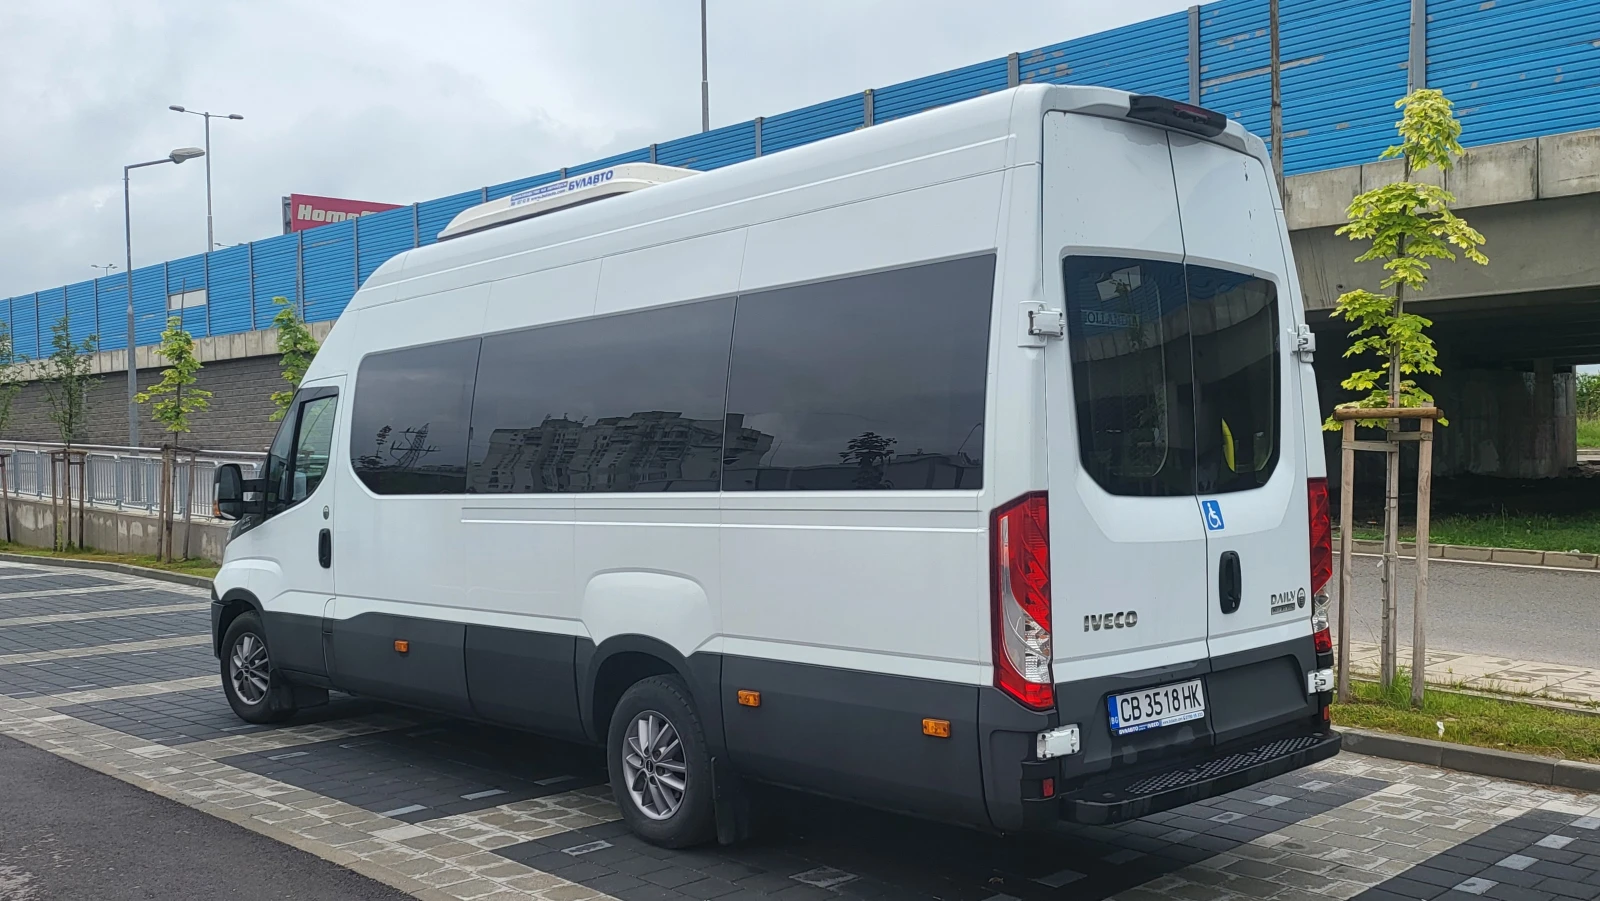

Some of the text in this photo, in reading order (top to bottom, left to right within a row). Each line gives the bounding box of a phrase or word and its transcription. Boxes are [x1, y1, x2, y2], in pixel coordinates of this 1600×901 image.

[568, 170, 614, 191] БУЛАВТО
[1270, 590, 1296, 605] DAILY
[1083, 610, 1138, 632] IVECO
[1120, 683, 1202, 723] CB 3518 HK
[1111, 716, 1119, 725] BG
